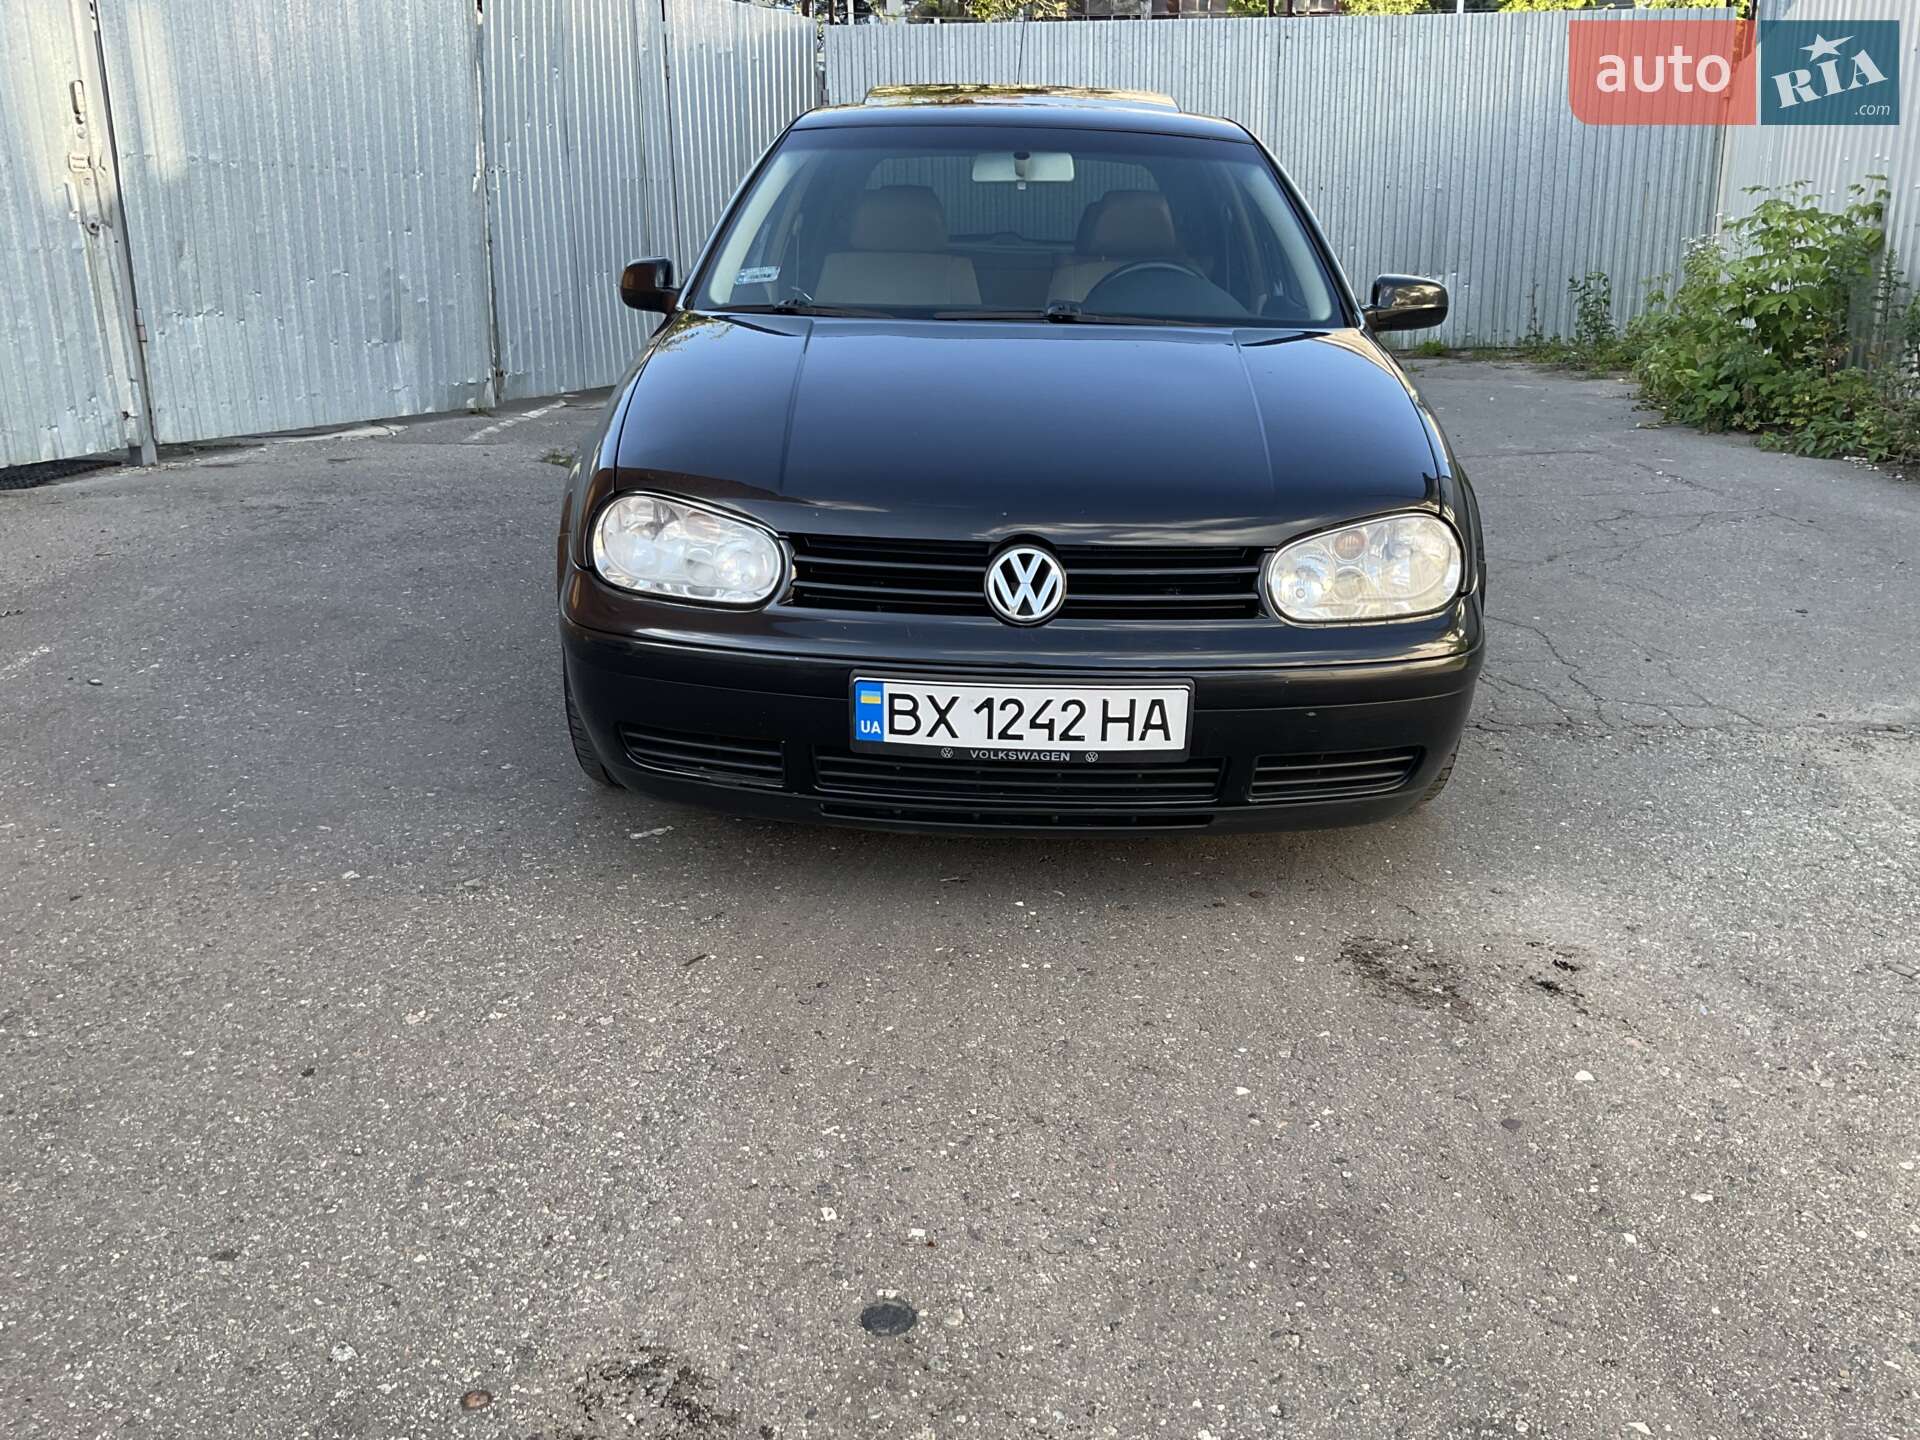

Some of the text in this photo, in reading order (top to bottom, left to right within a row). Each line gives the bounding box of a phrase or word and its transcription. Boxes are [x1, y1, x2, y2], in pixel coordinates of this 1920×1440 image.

[988, 548, 1063, 620] VW
[860, 720, 881, 734] UA
[888, 692, 1171, 742] BX 1242 HA
[970, 750, 1071, 762] VOLKSWAGEN
